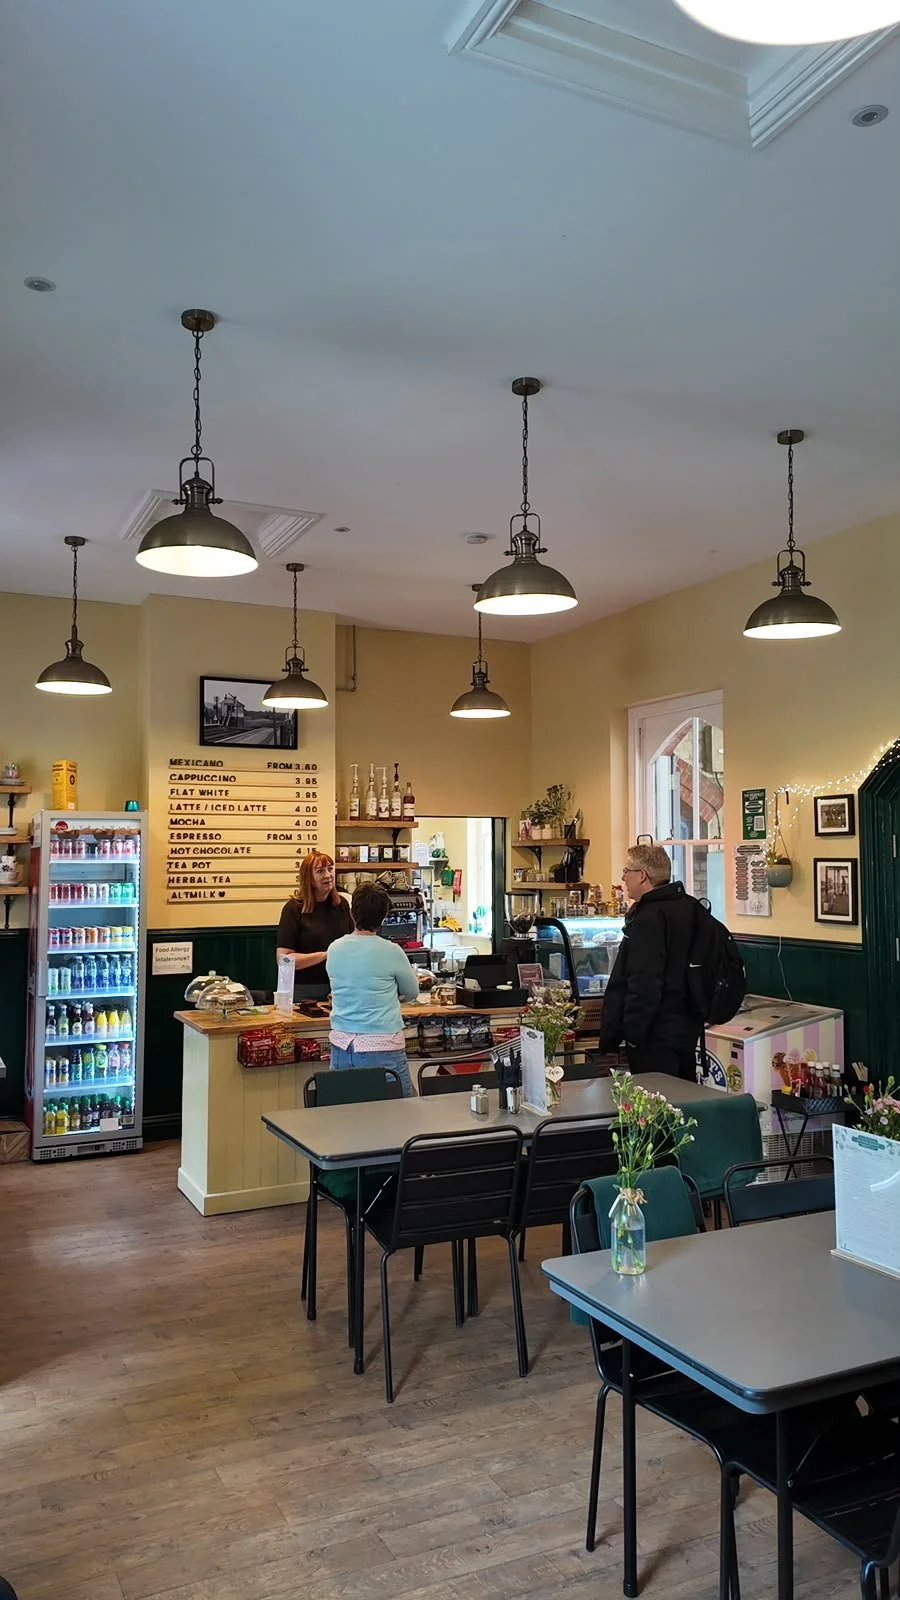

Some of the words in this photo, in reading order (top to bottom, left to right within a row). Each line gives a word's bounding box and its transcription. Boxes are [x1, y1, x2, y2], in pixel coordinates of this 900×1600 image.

[169, 759, 224, 767] MEXICANO
[267, 762, 293, 770] FROM
[169, 774, 237, 783] CAPPUCCINO
[199, 789, 230, 797] WHITE
[211, 804, 235, 812] ICED
[238, 804, 267, 812] LATTE
[171, 847, 191, 855] HOT
[193, 847, 251, 855] CHOCOLATE
[168, 876, 208, 884] HERBAL
